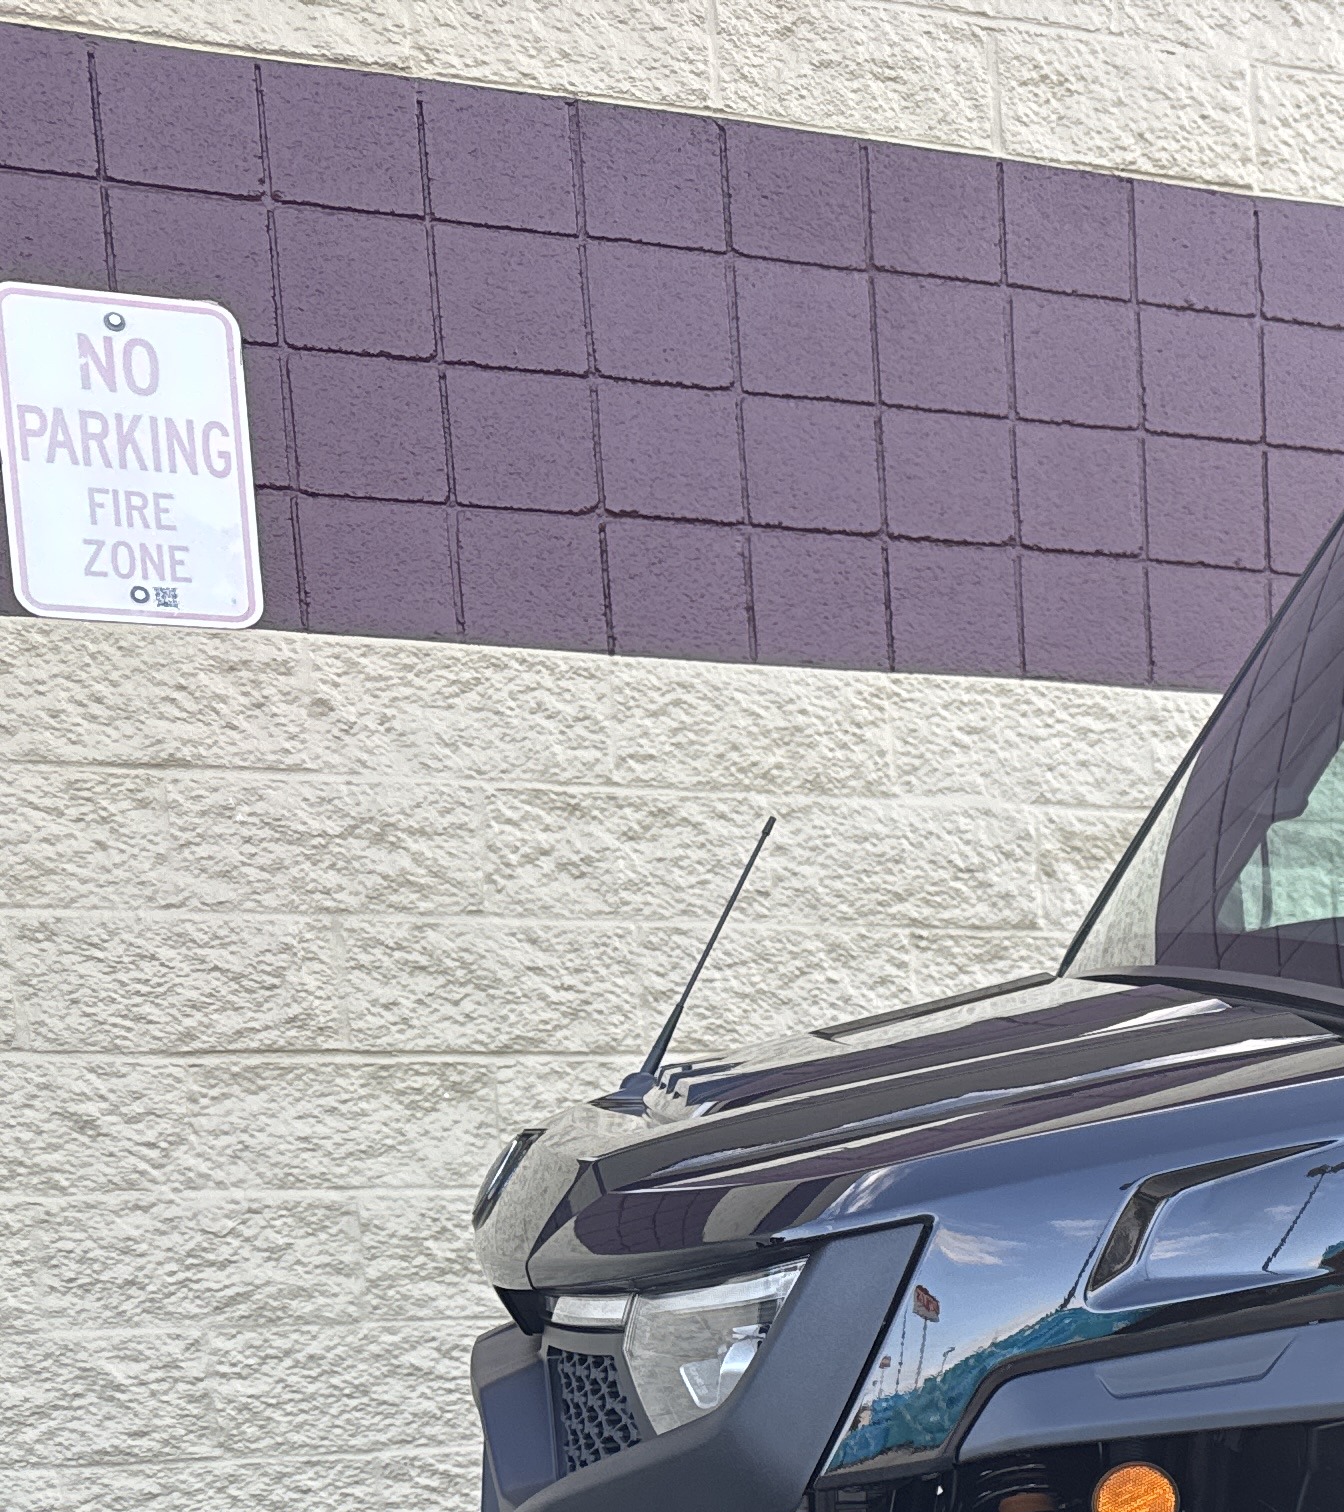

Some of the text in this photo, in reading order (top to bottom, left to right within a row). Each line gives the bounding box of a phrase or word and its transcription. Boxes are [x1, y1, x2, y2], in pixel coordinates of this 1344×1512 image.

[77, 332, 160, 397] NO
[16, 403, 233, 479] PARKING
[87, 487, 178, 532] FIRE
[82, 538, 193, 583] ZONE
